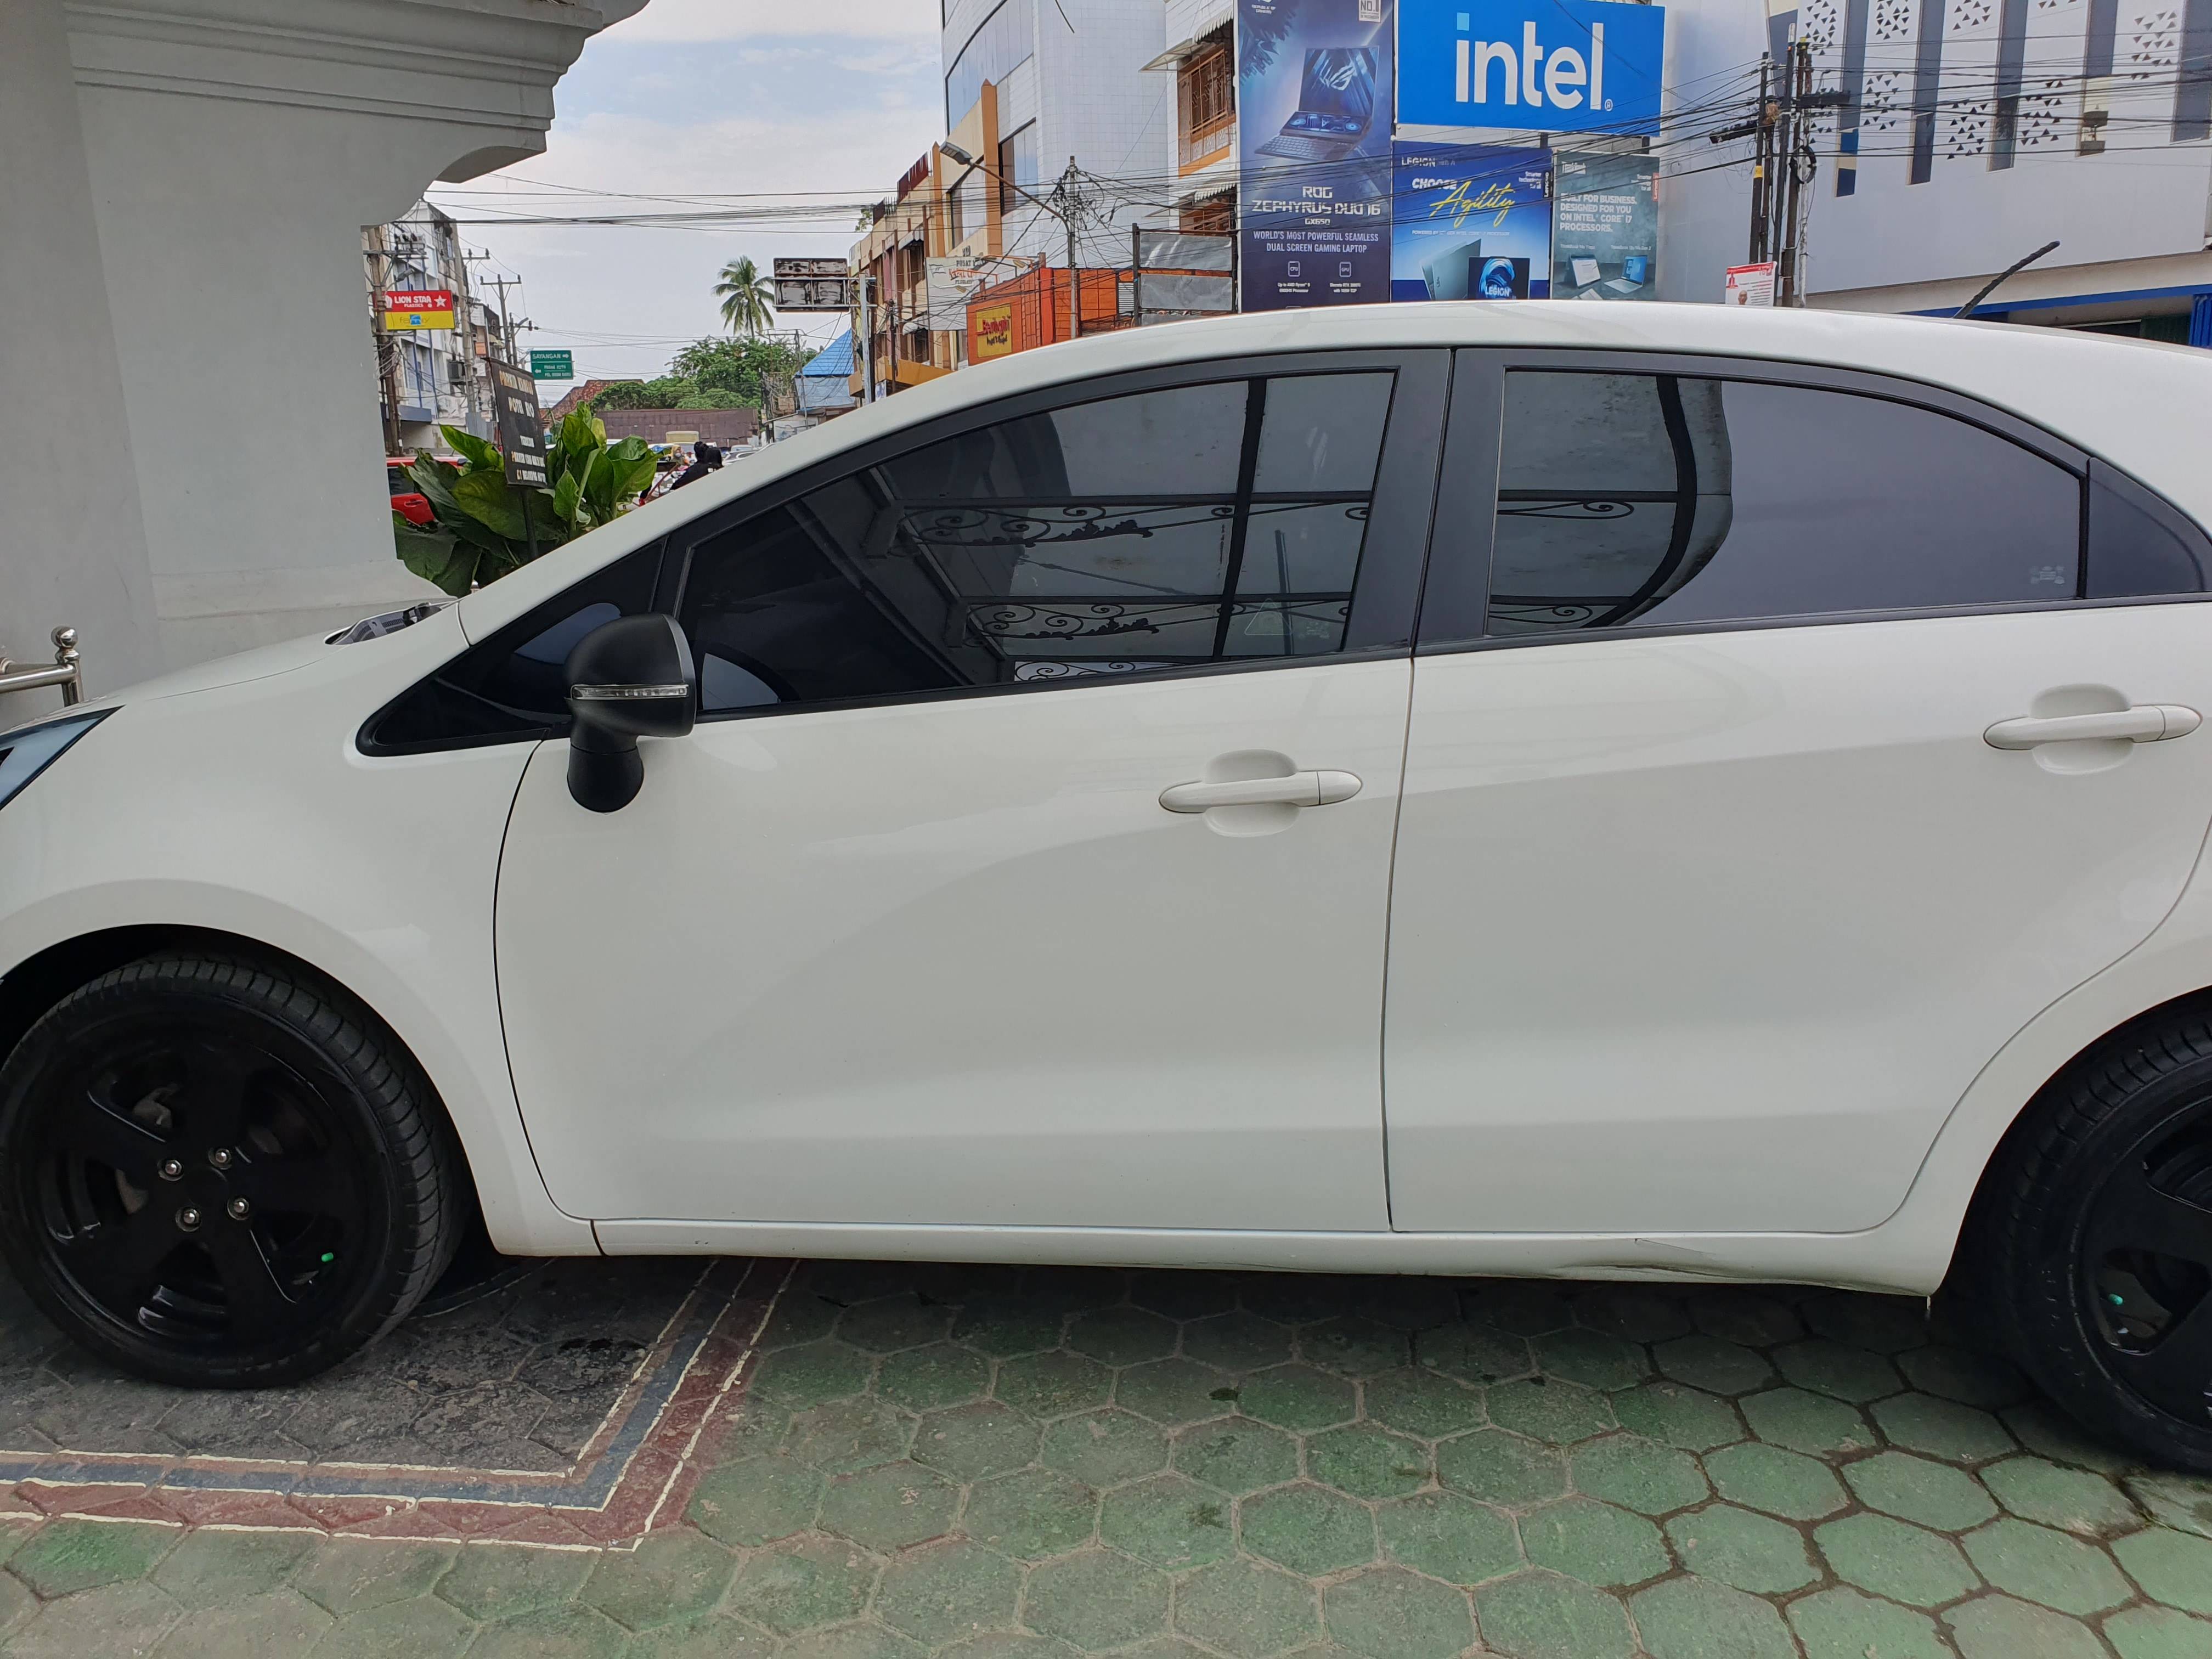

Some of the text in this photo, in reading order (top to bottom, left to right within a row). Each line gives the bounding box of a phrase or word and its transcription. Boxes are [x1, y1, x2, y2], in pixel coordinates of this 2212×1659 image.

[1455, 12, 1604, 110] intel
[1302, 186, 1333, 199] ROG
[1583, 194, 1599, 203] FOR
[1251, 200, 1332, 214] ZEPHYRUS
[1334, 203, 1363, 215] DUO
[1560, 203, 1632, 214] DESIGNED FOR YOU
[1560, 213, 1572, 221] ON
[1560, 222, 1613, 233] PROCESSORS.
[1253, 231, 1379, 242] WORLD'S MOST POWERFUL SEAMLESS
[1266, 243, 1367, 253] DUAL SCREEN GAMING LAPTOP
[1485, 285, 1510, 297] LEGION
[394, 295, 432, 304] LION STAR
